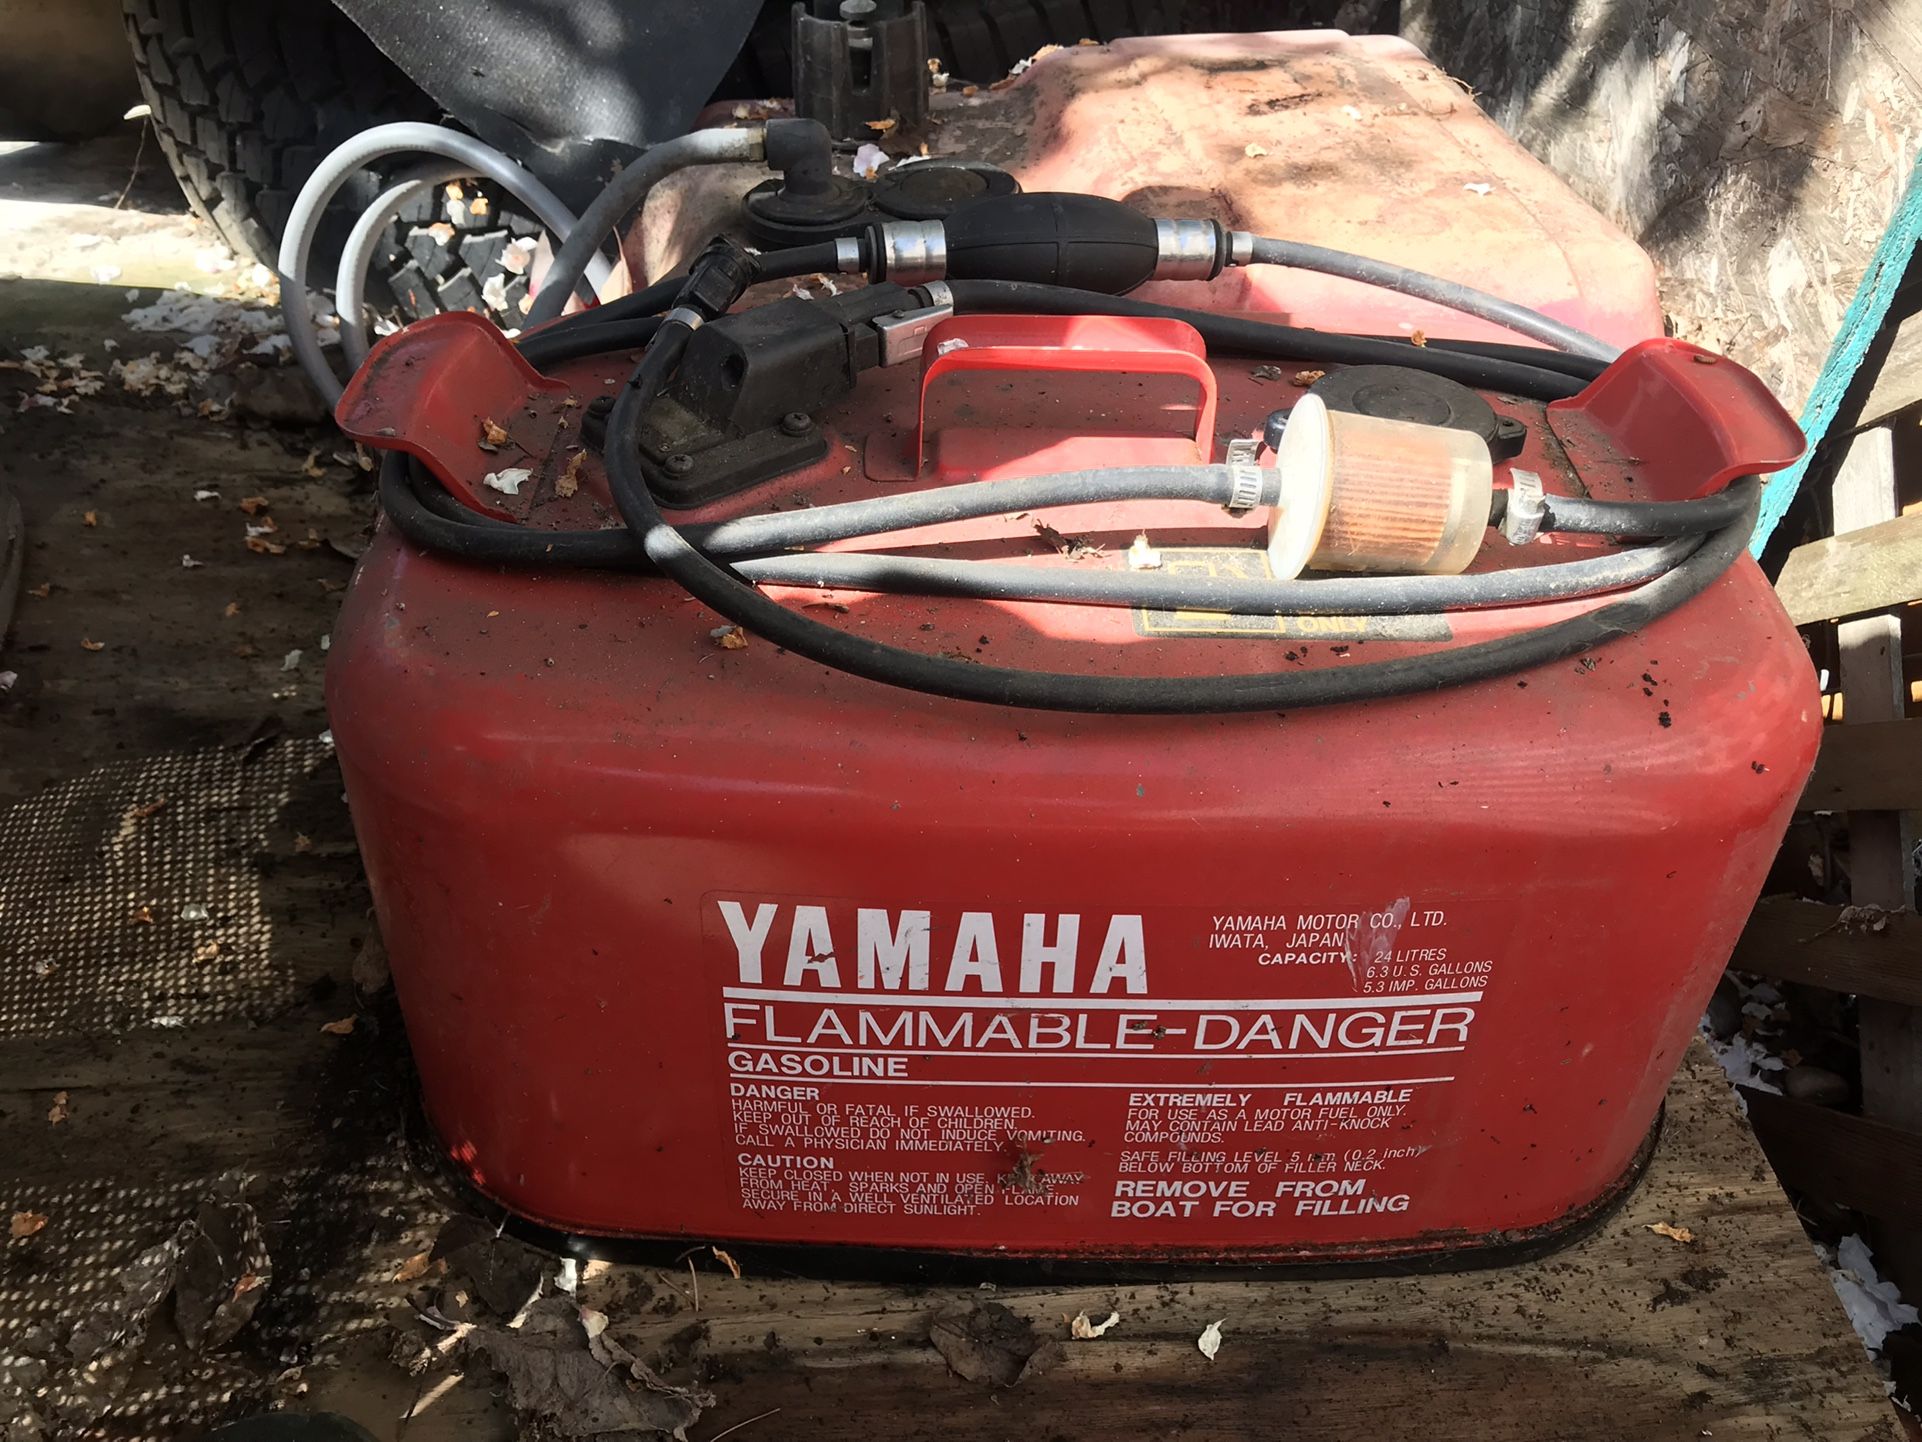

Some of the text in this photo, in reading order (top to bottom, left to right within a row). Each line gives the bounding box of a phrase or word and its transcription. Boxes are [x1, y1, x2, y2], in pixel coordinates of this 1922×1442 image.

[1212, 911, 1448, 931] YAMAHA MOTOR CO., LTD.
[717, 900, 1148, 995] YAMAHA
[1209, 932, 1344, 950] IWATA, JAPAN
[1258, 948, 1447, 965] CAPACITY: 24 LITRES
[1366, 964, 1389, 979] 6.3
[1429, 960, 1493, 976] GALLONS
[1363, 975, 1488, 993] 5.3 IMP. GALLONS
[728, 1051, 908, 1076] GASOLINE
[730, 1083, 819, 1100] DANGER
[1128, 1089, 1412, 1107] EXTREMELY FLAMMABLE
[731, 1100, 1036, 1119] HARMFUL OR FATAL IF SWALLOWED.
[1128, 1104, 1407, 1120] FOR USE AS A MOTOR FUEL ONLY.
[733, 1112, 1018, 1130] KEEP OUT OF REACH OF CHILDREN.
[1126, 1117, 1391, 1132] MAY CONTAIN LEAD ANTI-KNOCK
[734, 1123, 1086, 1142] IF SWALLOWED DO NOT INDUCE VOMITING.
[1124, 1131, 1225, 1144] COMPOUNDS.
[735, 1135, 1007, 1152] CALL A PHYSICIAN IMMEDIATELY.
[737, 1153, 834, 1169] CAUTION
[1120, 1150, 1160, 1162] SAFE
[1167, 1151, 1225, 1163] FILLING
[1232, 1150, 1282, 1163] LEVEL
[1289, 1150, 1299, 1162] 5
[1343, 1148, 1376, 1162] (0.2
[1118, 1159, 1386, 1174] BELOW BOTTOM OF FILLER NECK.
[738, 1168, 777, 1179] KEEP
[783, 1169, 842, 1181] CLOSED
[848, 1172, 894, 1182] WHEN
[900, 1172, 930, 1183] NOT
[935, 1173, 949, 1183] IN
[956, 1173, 988, 1184] USE.
[740, 1178, 783, 1190] FROM
[848, 1181, 909, 1193] SPARKS
[916, 1182, 948, 1194] AND
[954, 1183, 995, 1195] OPEN
[1115, 1178, 1366, 1198] REMOVE FROM
[742, 1188, 799, 1201] SECURE
[808, 1191, 822, 1202] IN
[831, 1191, 842, 1202] A
[849, 1192, 892, 1203] WELL
[1004, 1194, 1079, 1206] LOCATION
[1111, 1194, 1410, 1218] BOAT FOR FILLING
[742, 1199, 981, 1216] AWAY FROM DIRECT SUNLIGHT.
